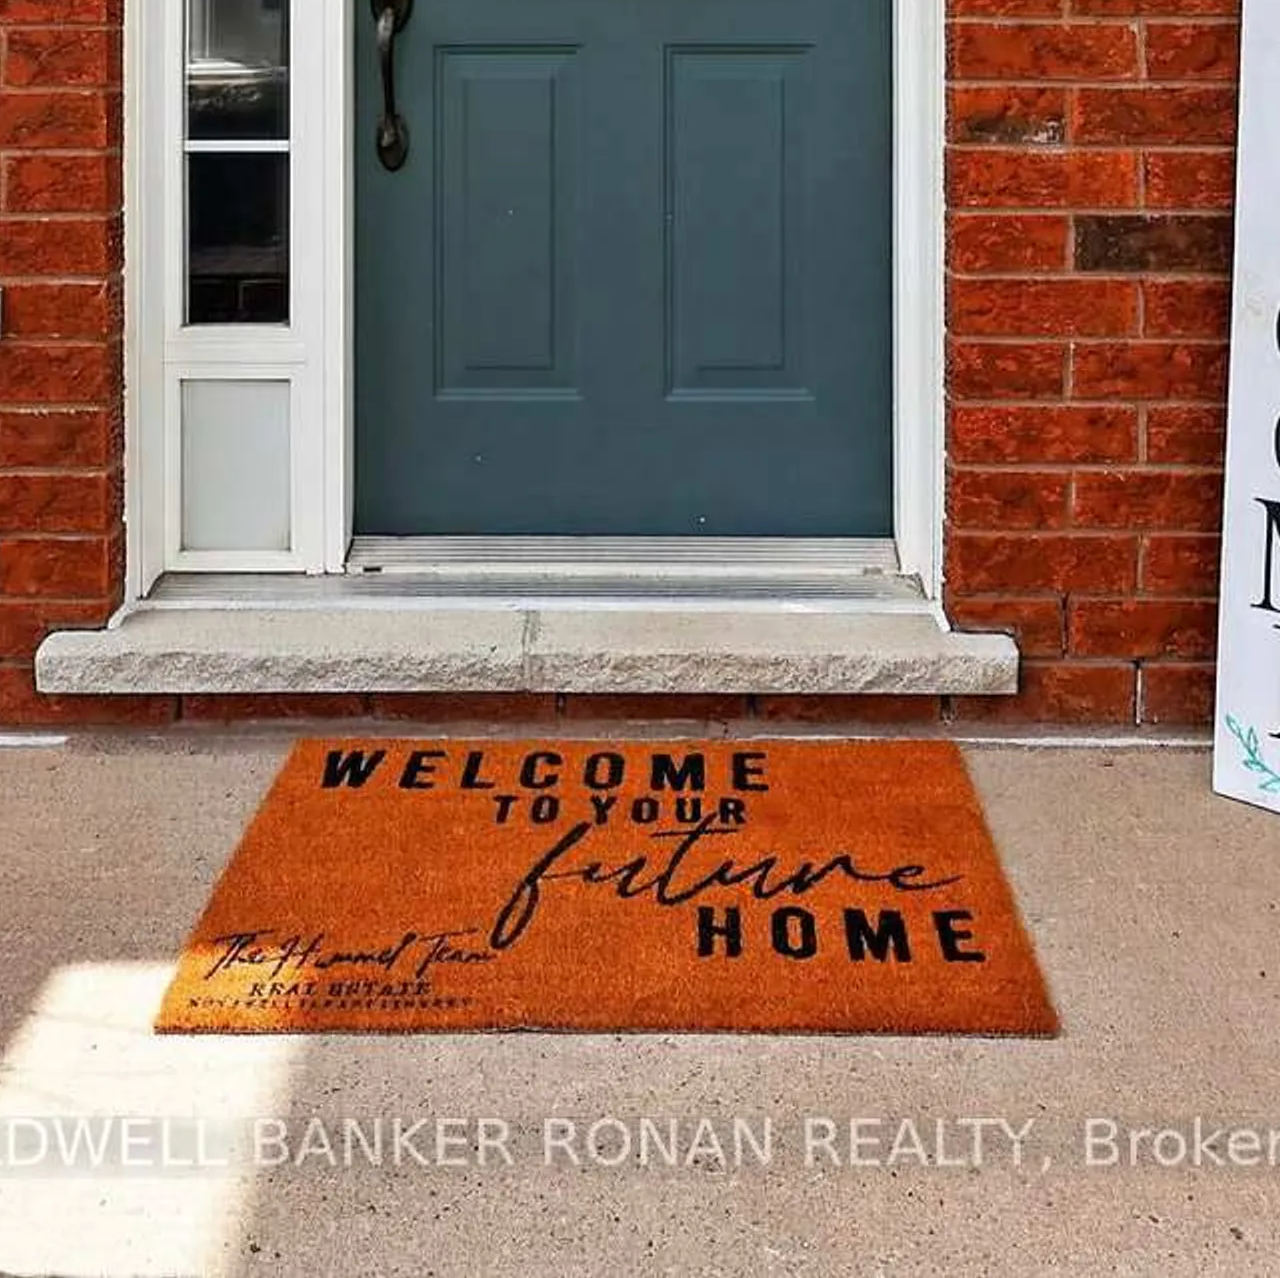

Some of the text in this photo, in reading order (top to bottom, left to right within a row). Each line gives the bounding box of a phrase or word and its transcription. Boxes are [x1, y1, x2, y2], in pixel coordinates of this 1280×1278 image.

[322, 750, 770, 792] WELCOME
[493, 795, 747, 825] TO YOUR
[489, 811, 962, 950] future
[696, 905, 988, 963] HOME
